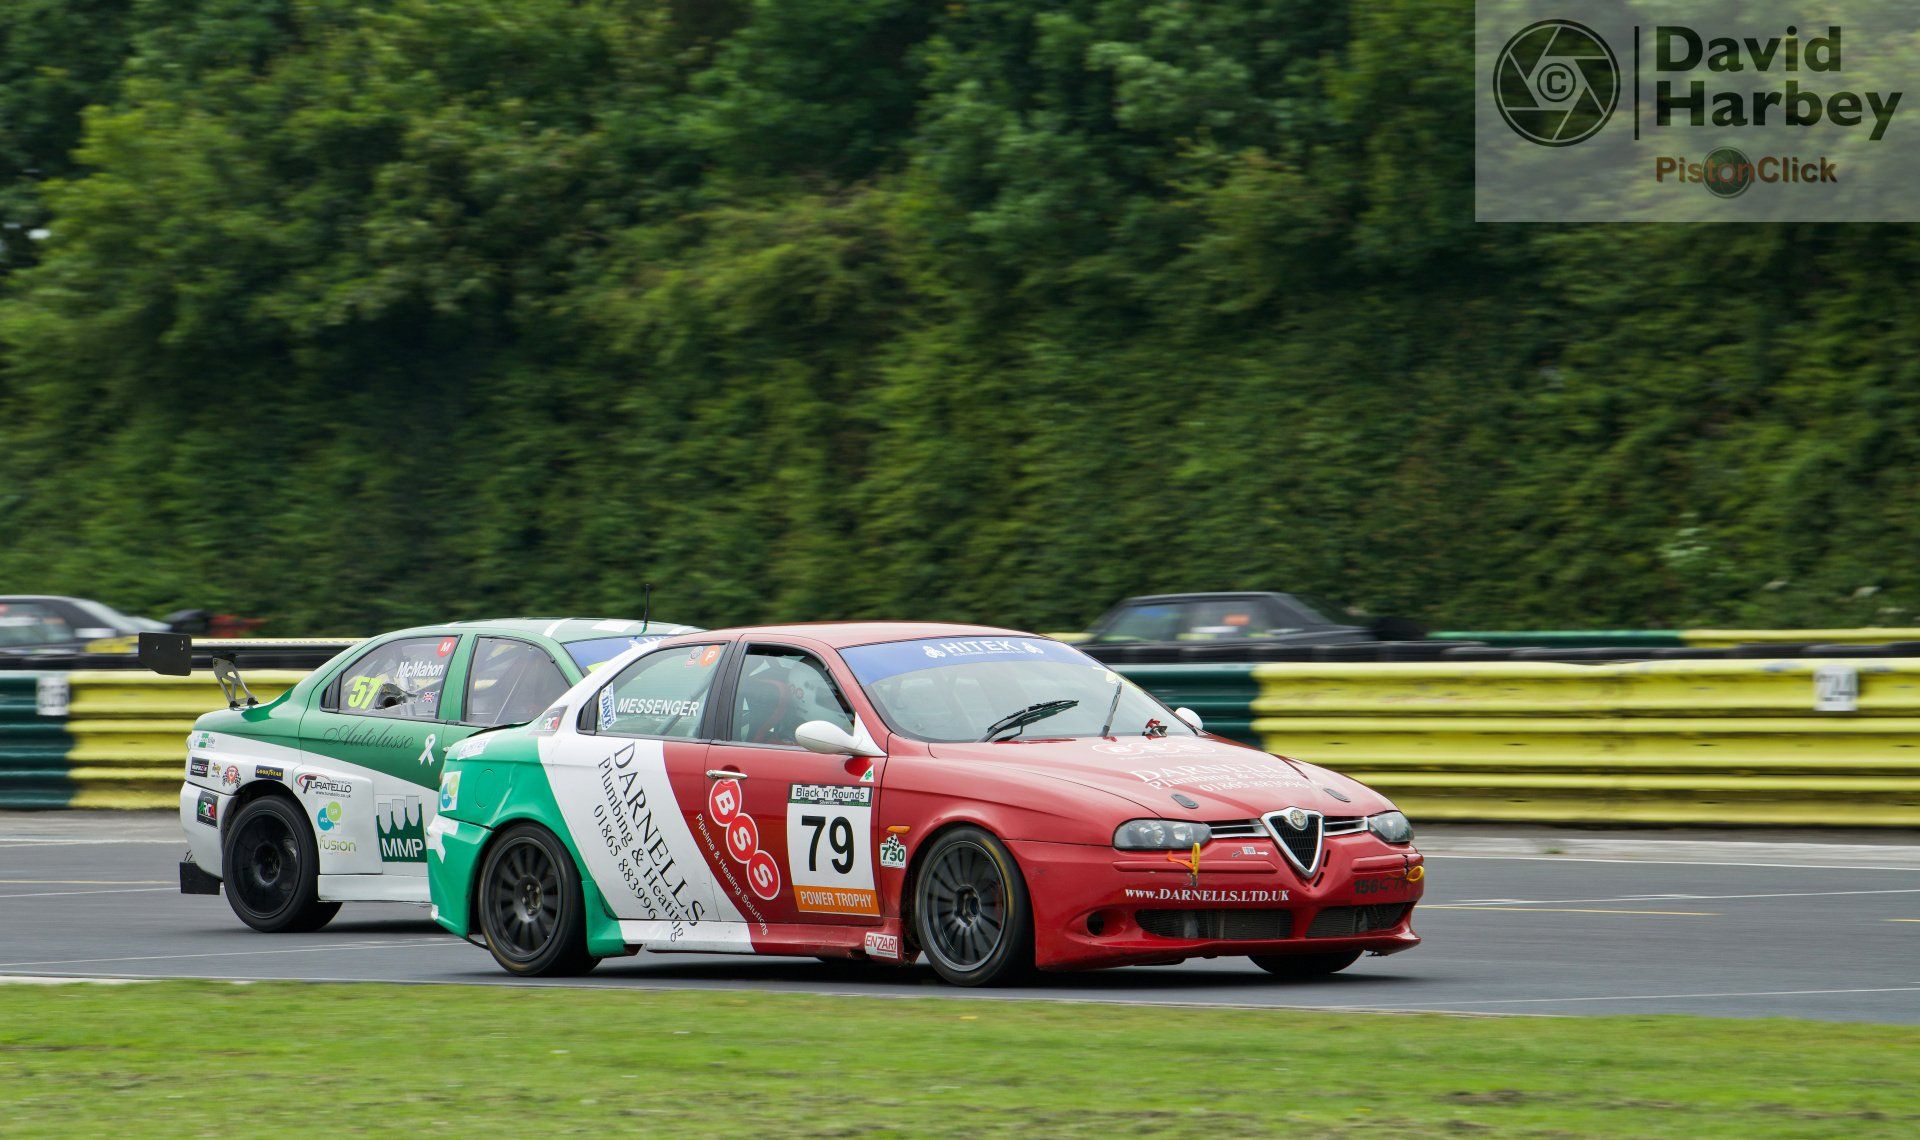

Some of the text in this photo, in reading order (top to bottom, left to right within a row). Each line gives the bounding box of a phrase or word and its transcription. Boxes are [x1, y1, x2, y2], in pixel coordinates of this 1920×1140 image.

[441, 642, 451, 652] M
[705, 650, 716, 661] P
[940, 640, 1021, 653] HITEK
[396, 661, 444, 678] McMahon
[347, 675, 383, 710] 57
[616, 698, 700, 717] MESSENGER
[323, 720, 414, 749] Autolusso
[302, 774, 352, 794] TURATELLO
[795, 787, 820, 798] Black
[831, 789, 865, 800] Rounds
[614, 741, 706, 926] DARNELLS
[320, 835, 357, 852] fusion
[381, 837, 424, 858] MMP
[598, 756, 684, 942] Plumbing & Heating
[802, 815, 854, 874] 79
[593, 804, 658, 920] 01865 883996
[881, 846, 905, 863] 750
[719, 858, 742, 896] Heating
[741, 894, 769, 936] Solutions
[800, 891, 872, 908] POWER TROPHY
[1124, 888, 1290, 902] www.DARNELLS.LTD.UK
[865, 934, 897, 951] ENZARI
